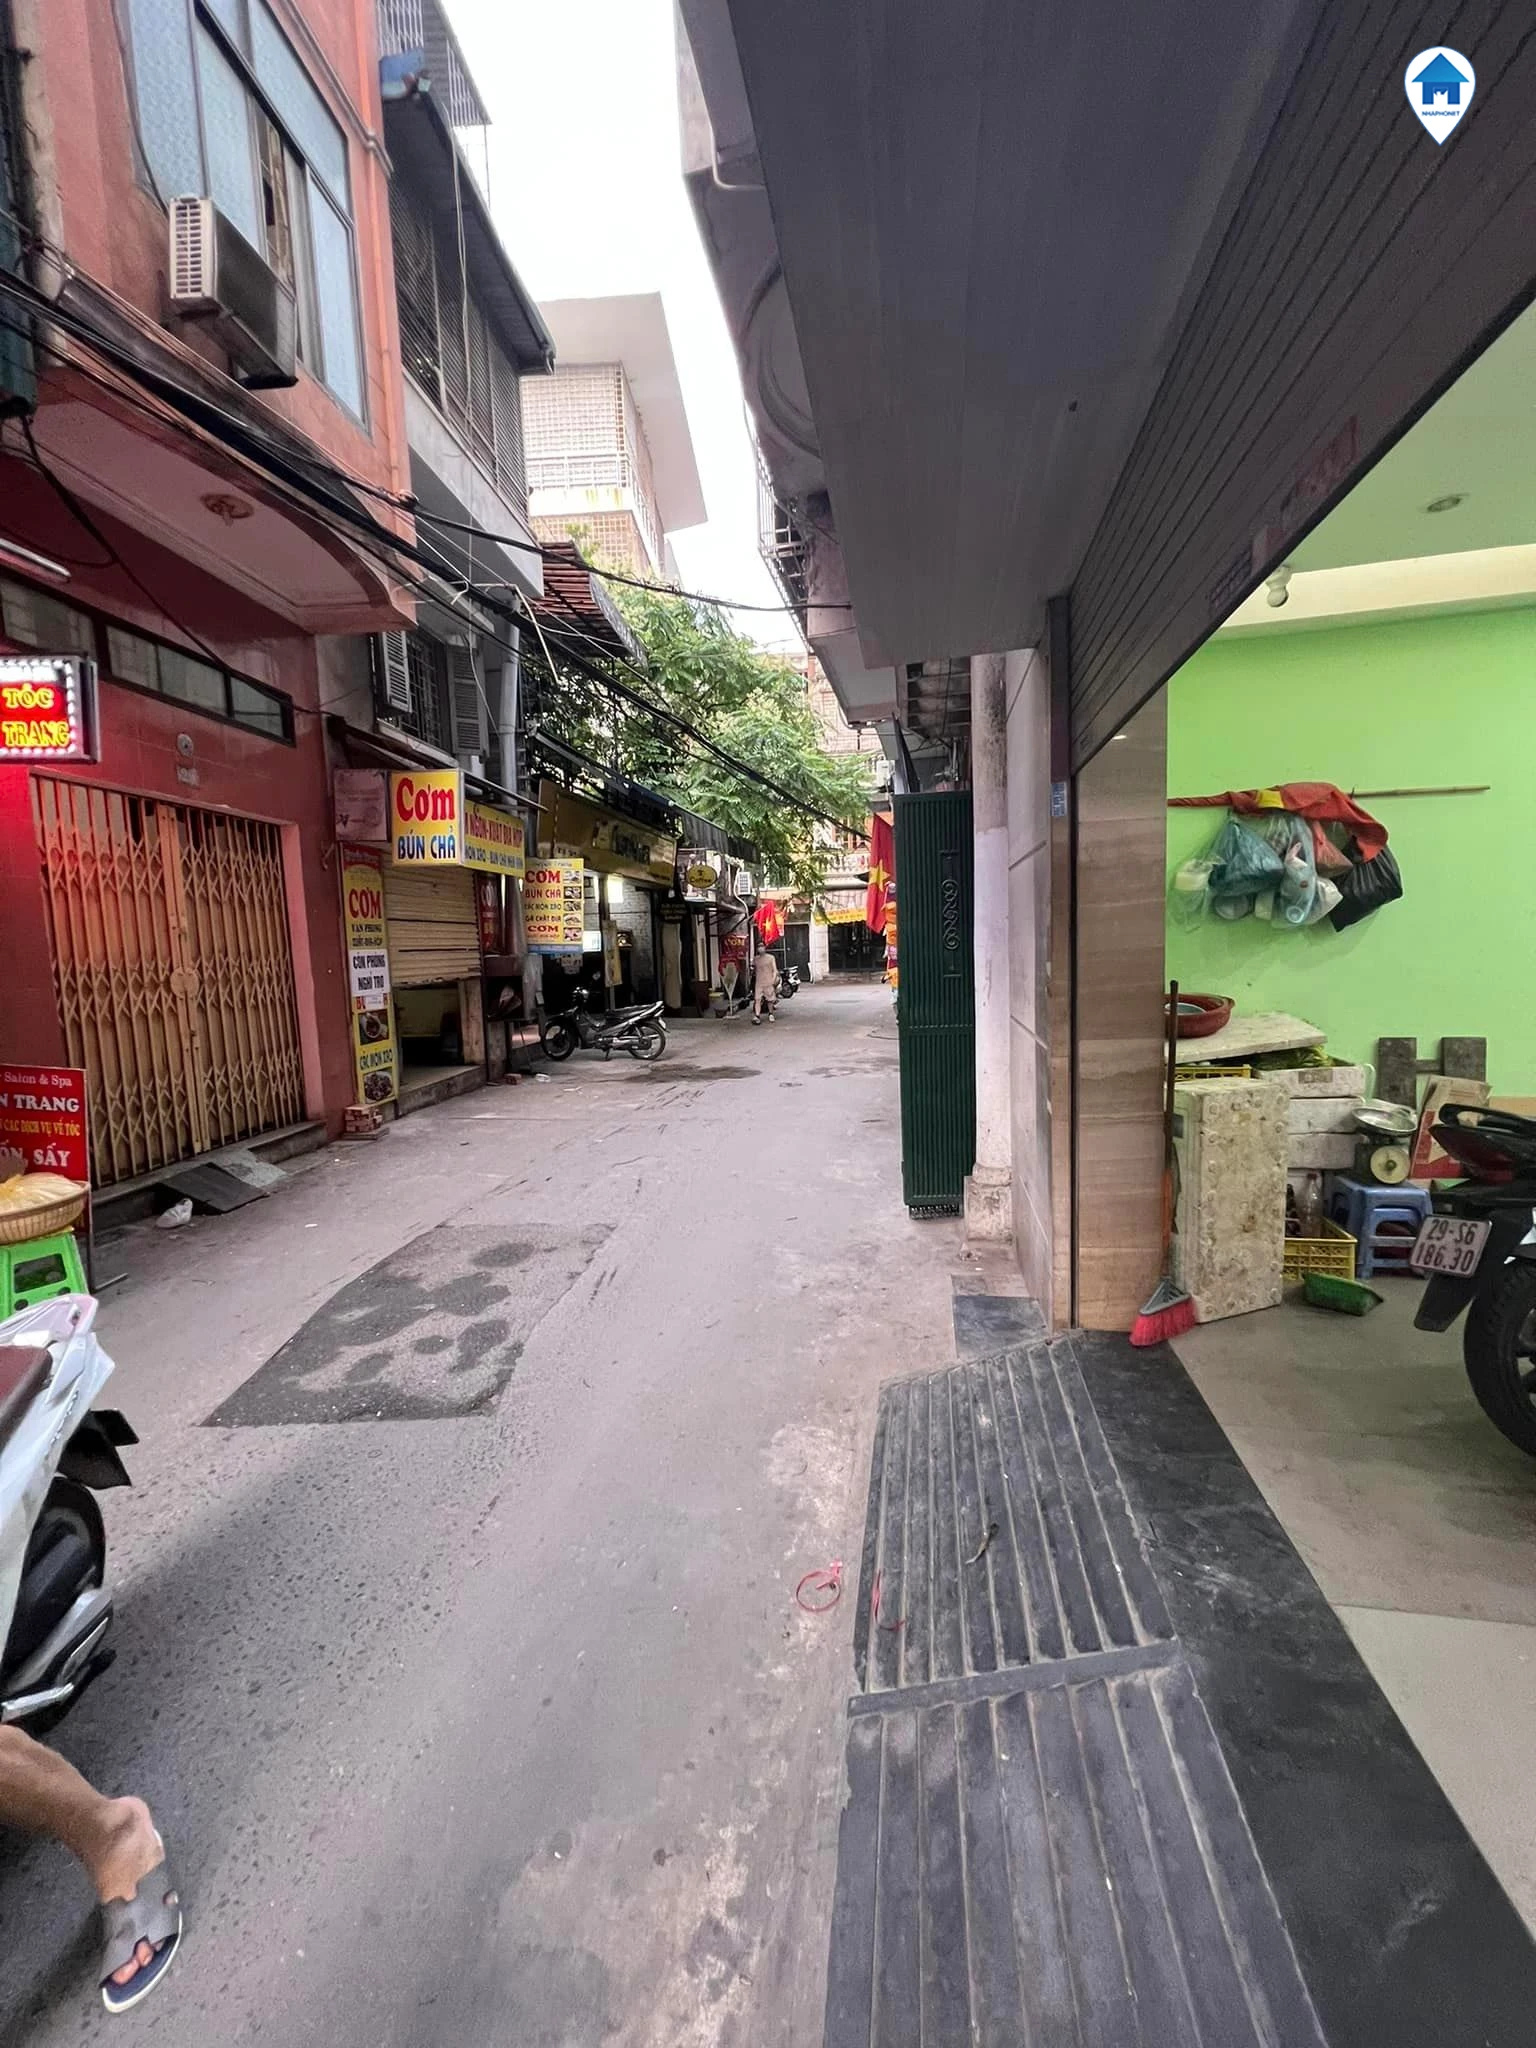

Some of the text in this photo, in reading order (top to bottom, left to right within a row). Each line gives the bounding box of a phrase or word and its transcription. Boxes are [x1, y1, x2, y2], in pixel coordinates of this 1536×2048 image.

[2, 721, 70, 747] TRANG
[396, 776, 456, 822] Cơm
[397, 829, 426, 860] BÚN
[430, 825, 456, 860] CHẢ
[525, 869, 561, 884] CƠM
[349, 887, 382, 920] CƠM
[4, 1072, 36, 1084] Salon
[39, 1074, 49, 1085] &
[51, 1075, 72, 1089] Spa
[13, 1094, 80, 1113] TRANG
[33, 1142, 71, 1168] SẤY
[1416, 1242, 1475, 1272] 186.30
